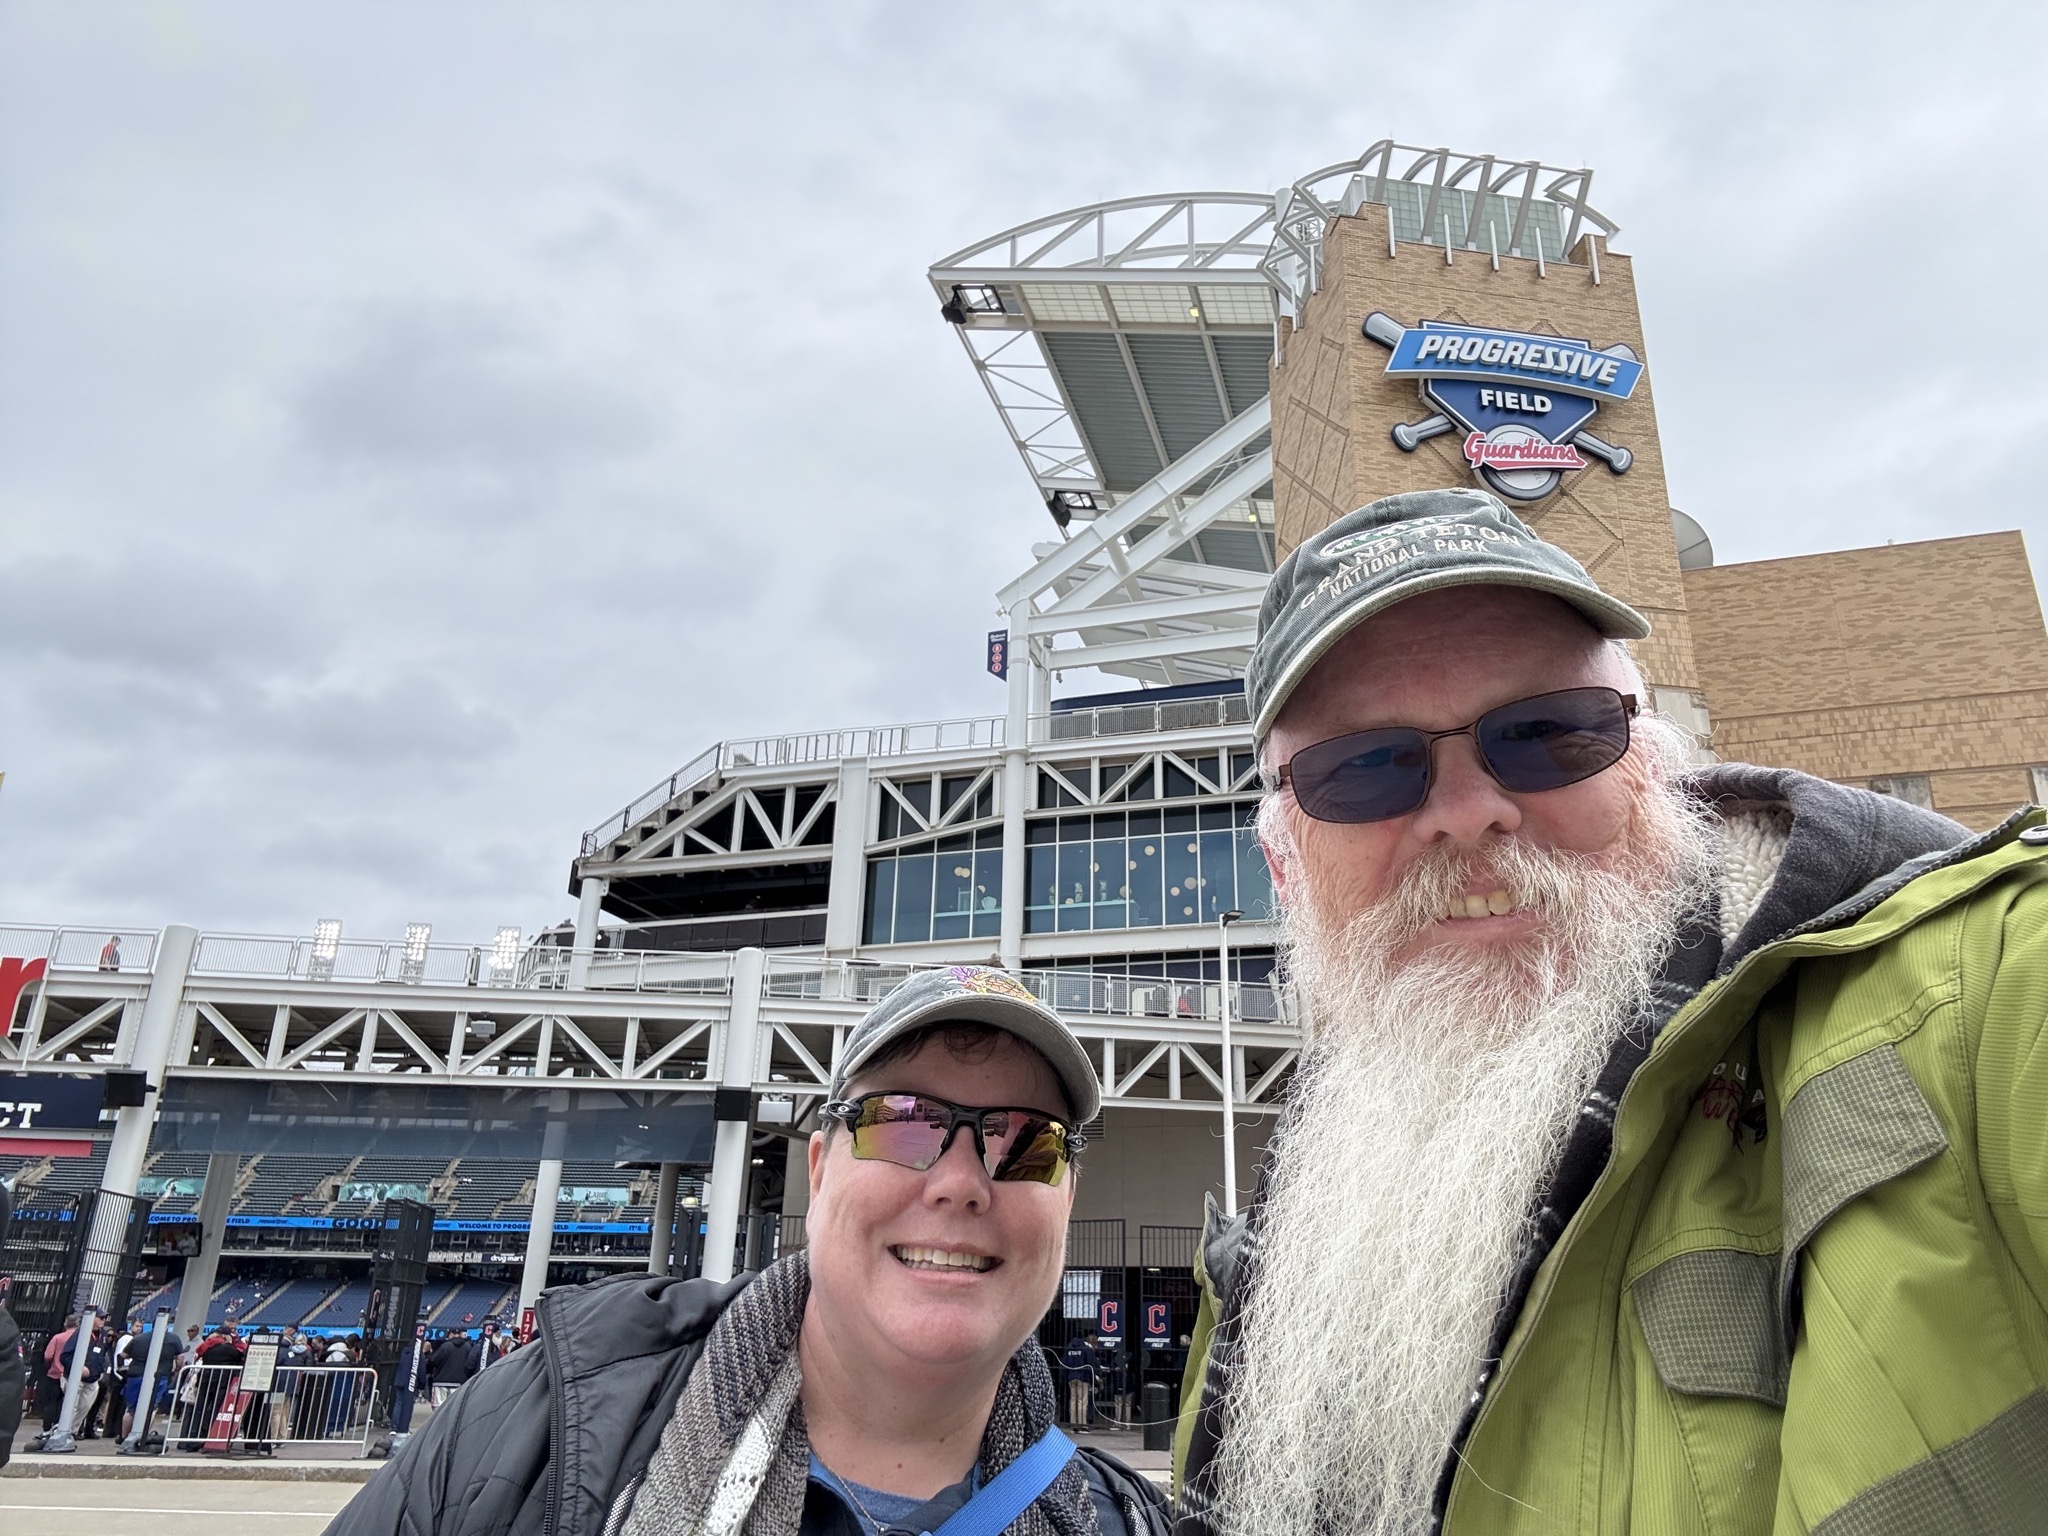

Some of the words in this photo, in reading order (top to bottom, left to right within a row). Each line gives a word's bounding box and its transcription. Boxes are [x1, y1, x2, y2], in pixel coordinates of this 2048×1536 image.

[1415, 334, 1622, 385] PROGRESSIVE
[1480, 389, 1552, 413] FIELD
[1464, 431, 1588, 470] Guardians
[1300, 537, 1398, 610] GRAND
[1409, 523, 1521, 548] TETON
[1329, 546, 1425, 600] NATIONAL
[1434, 539, 1488, 553] PARK
[492, 1222, 501, 1230] TO
[490, 1254, 507, 1263] drug
[507, 1254, 524, 1262] mart
[1101, 1301, 1118, 1333] C
[1148, 1304, 1167, 1334] C
[408, 1374, 418, 1393] FIELD
